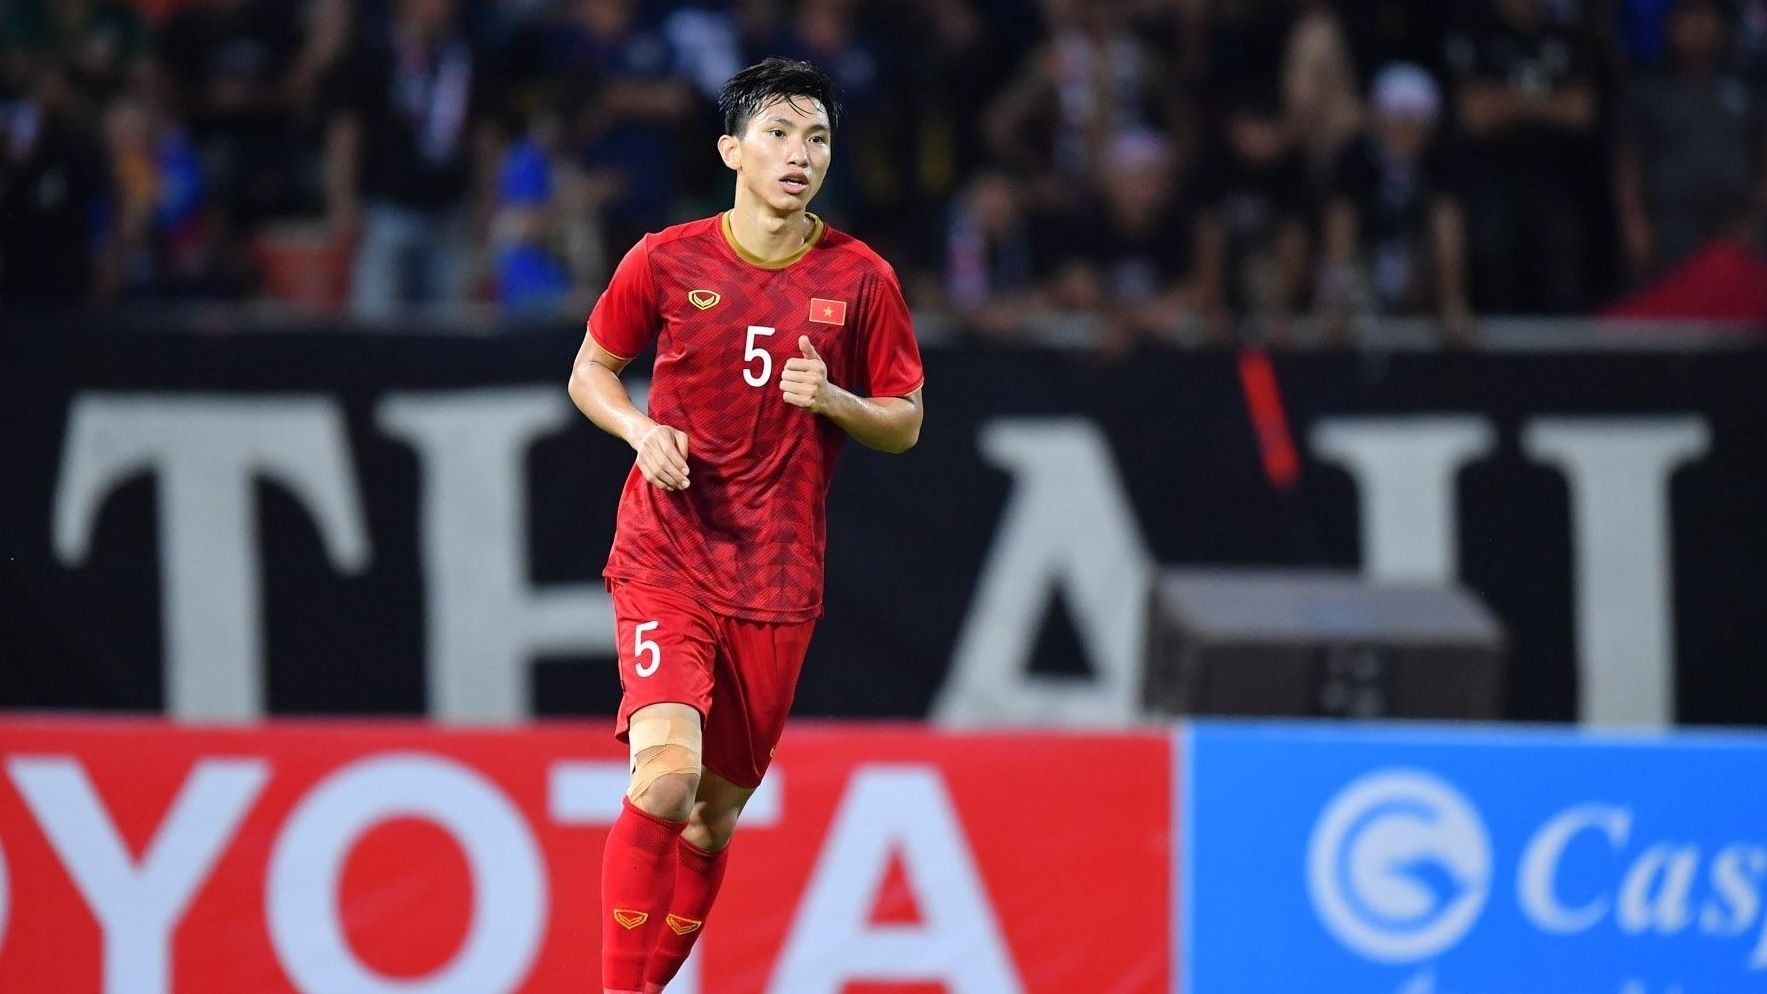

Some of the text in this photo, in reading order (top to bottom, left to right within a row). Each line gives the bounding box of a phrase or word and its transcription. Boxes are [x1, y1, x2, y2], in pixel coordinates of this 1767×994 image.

[742, 325, 776, 388] 5
[633, 620, 661, 678] 5
[0, 752, 1030, 994] YOA
[1516, 802, 1767, 970] Cas
